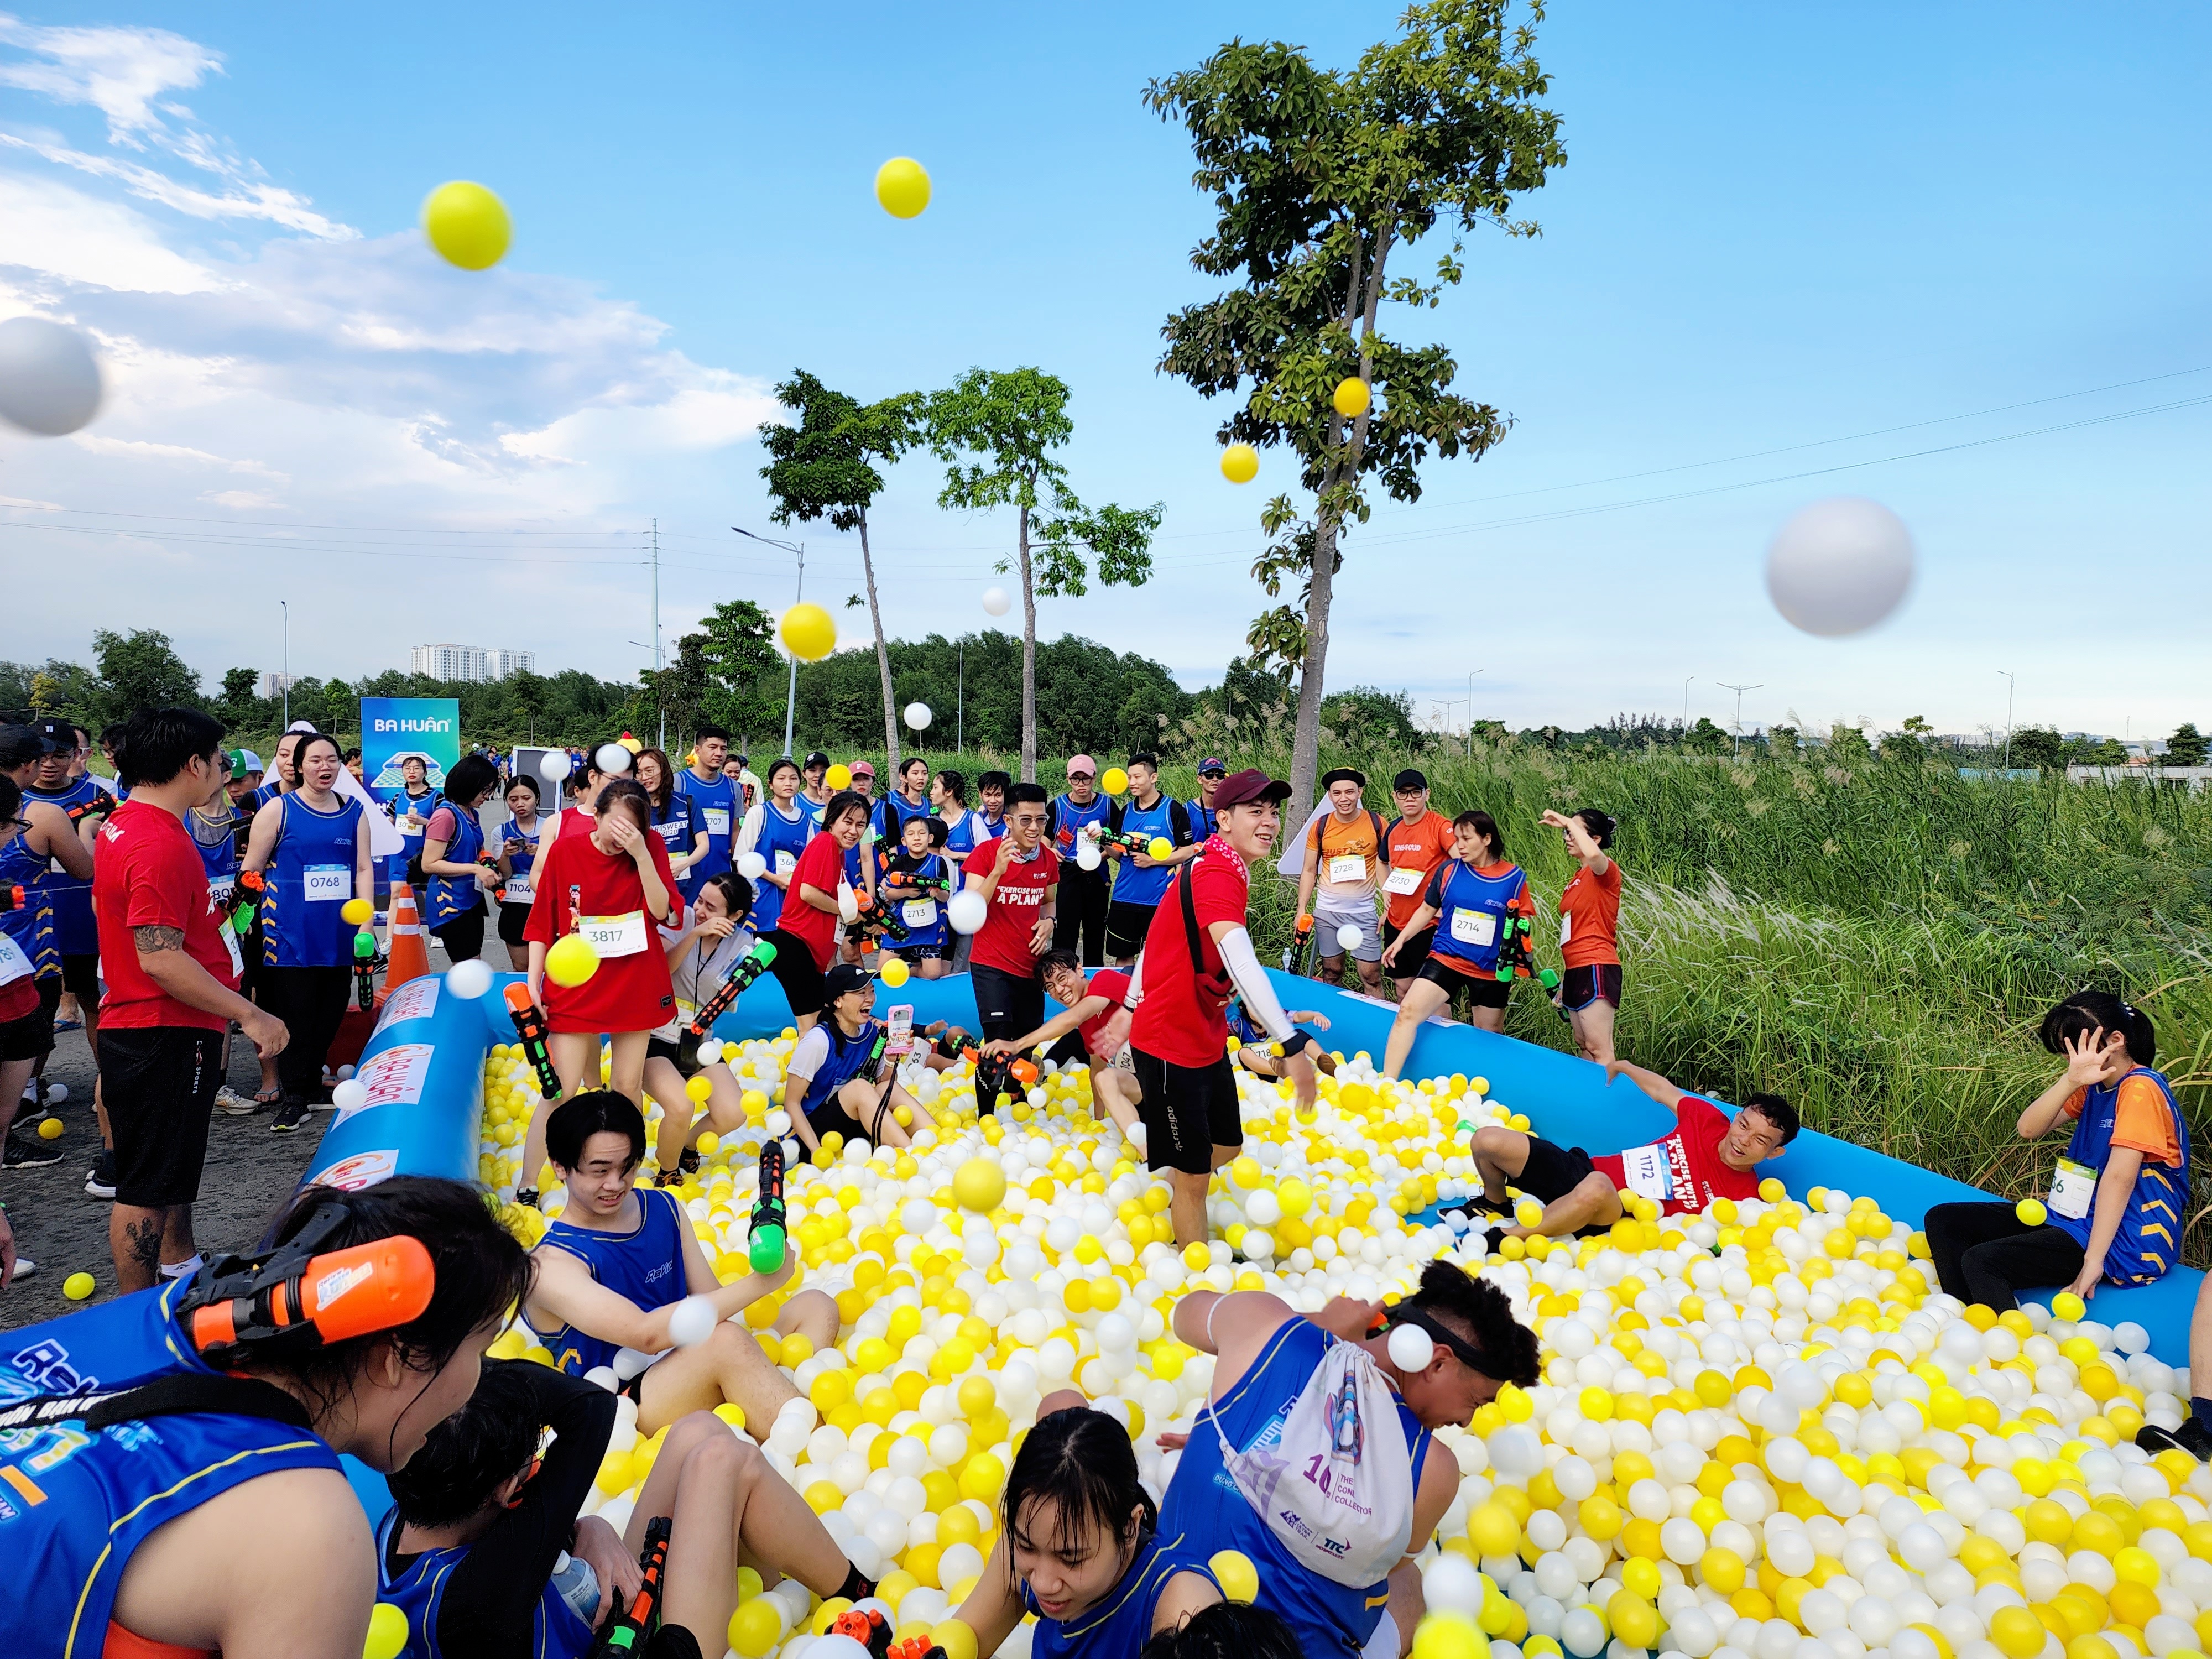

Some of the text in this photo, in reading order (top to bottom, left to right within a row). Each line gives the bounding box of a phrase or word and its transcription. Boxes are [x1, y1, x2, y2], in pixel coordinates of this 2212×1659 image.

[374, 719, 398, 732] BA
[662, 821, 688, 831] SWEAT
[1334, 864, 1353, 873] 2728
[310, 877, 340, 888] 0768
[1389, 876, 1410, 885] 2730
[509, 883, 531, 893] 1104
[997, 893, 1006, 904] A
[906, 909, 925, 918] 2713
[1456, 920, 1479, 932] 2714
[589, 930, 623, 942] 3817
[1120, 1052, 1132, 1070] 1047
[192, 1066, 201, 1094] SPORTS
[1167, 1105, 1178, 1141] adidas
[1639, 1154, 1655, 1180] 1172
[1684, 1181, 1699, 1208] WITH
[1340, 1474, 1354, 1485] THE
[1334, 1495, 1372, 1516] COLLECTOR
[1324, 1537, 1345, 1554] TTC
